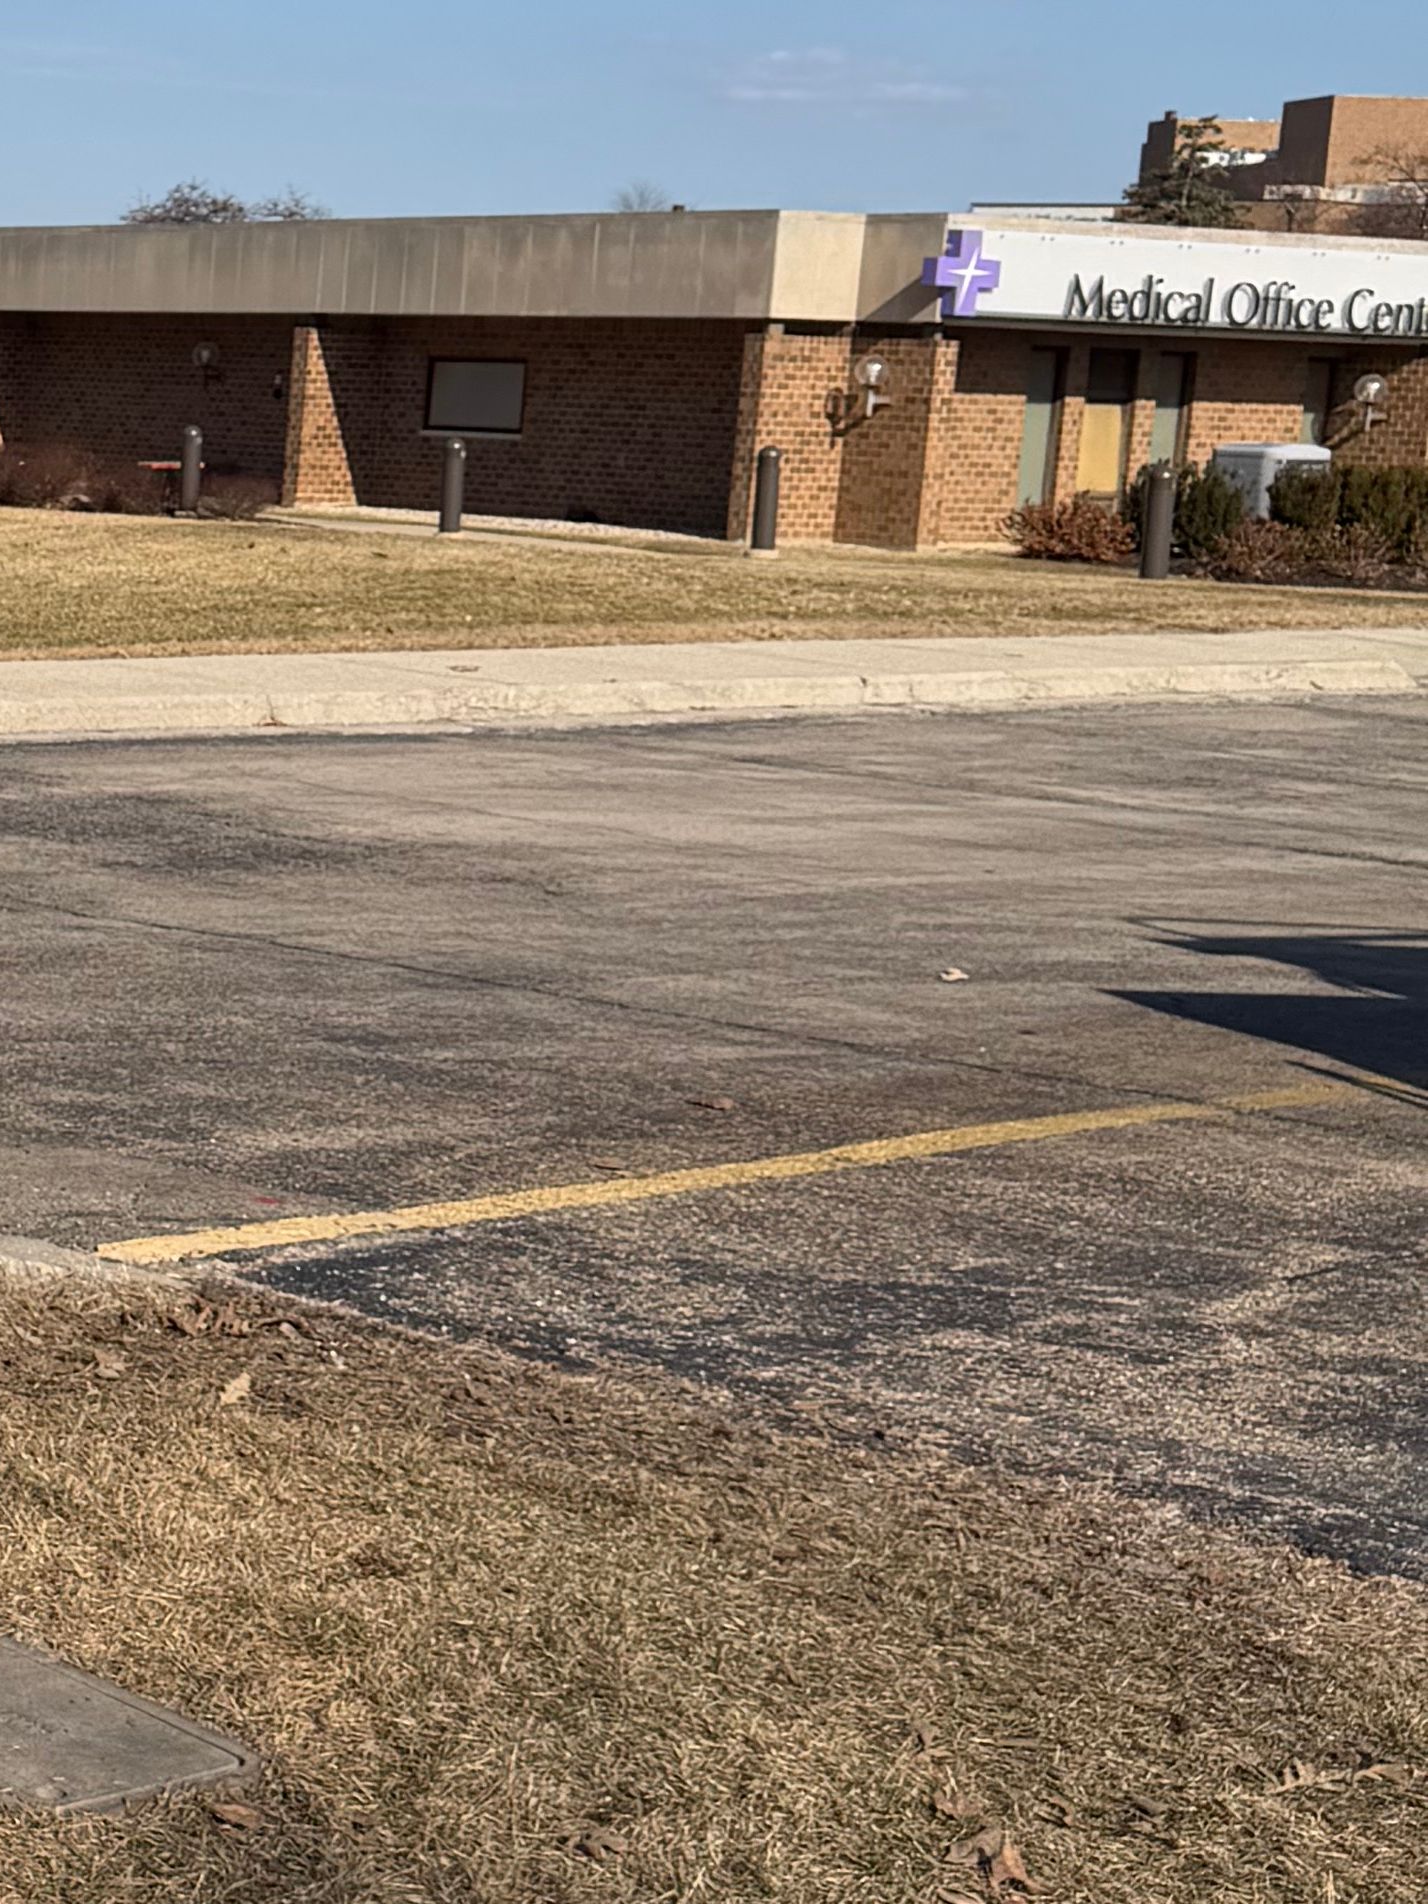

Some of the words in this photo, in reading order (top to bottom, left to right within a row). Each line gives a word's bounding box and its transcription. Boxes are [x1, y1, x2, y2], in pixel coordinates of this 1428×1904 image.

[1065, 273, 1214, 324] Medical
[1224, 282, 1334, 330] Office
[1342, 288, 1428, 335] Cent
